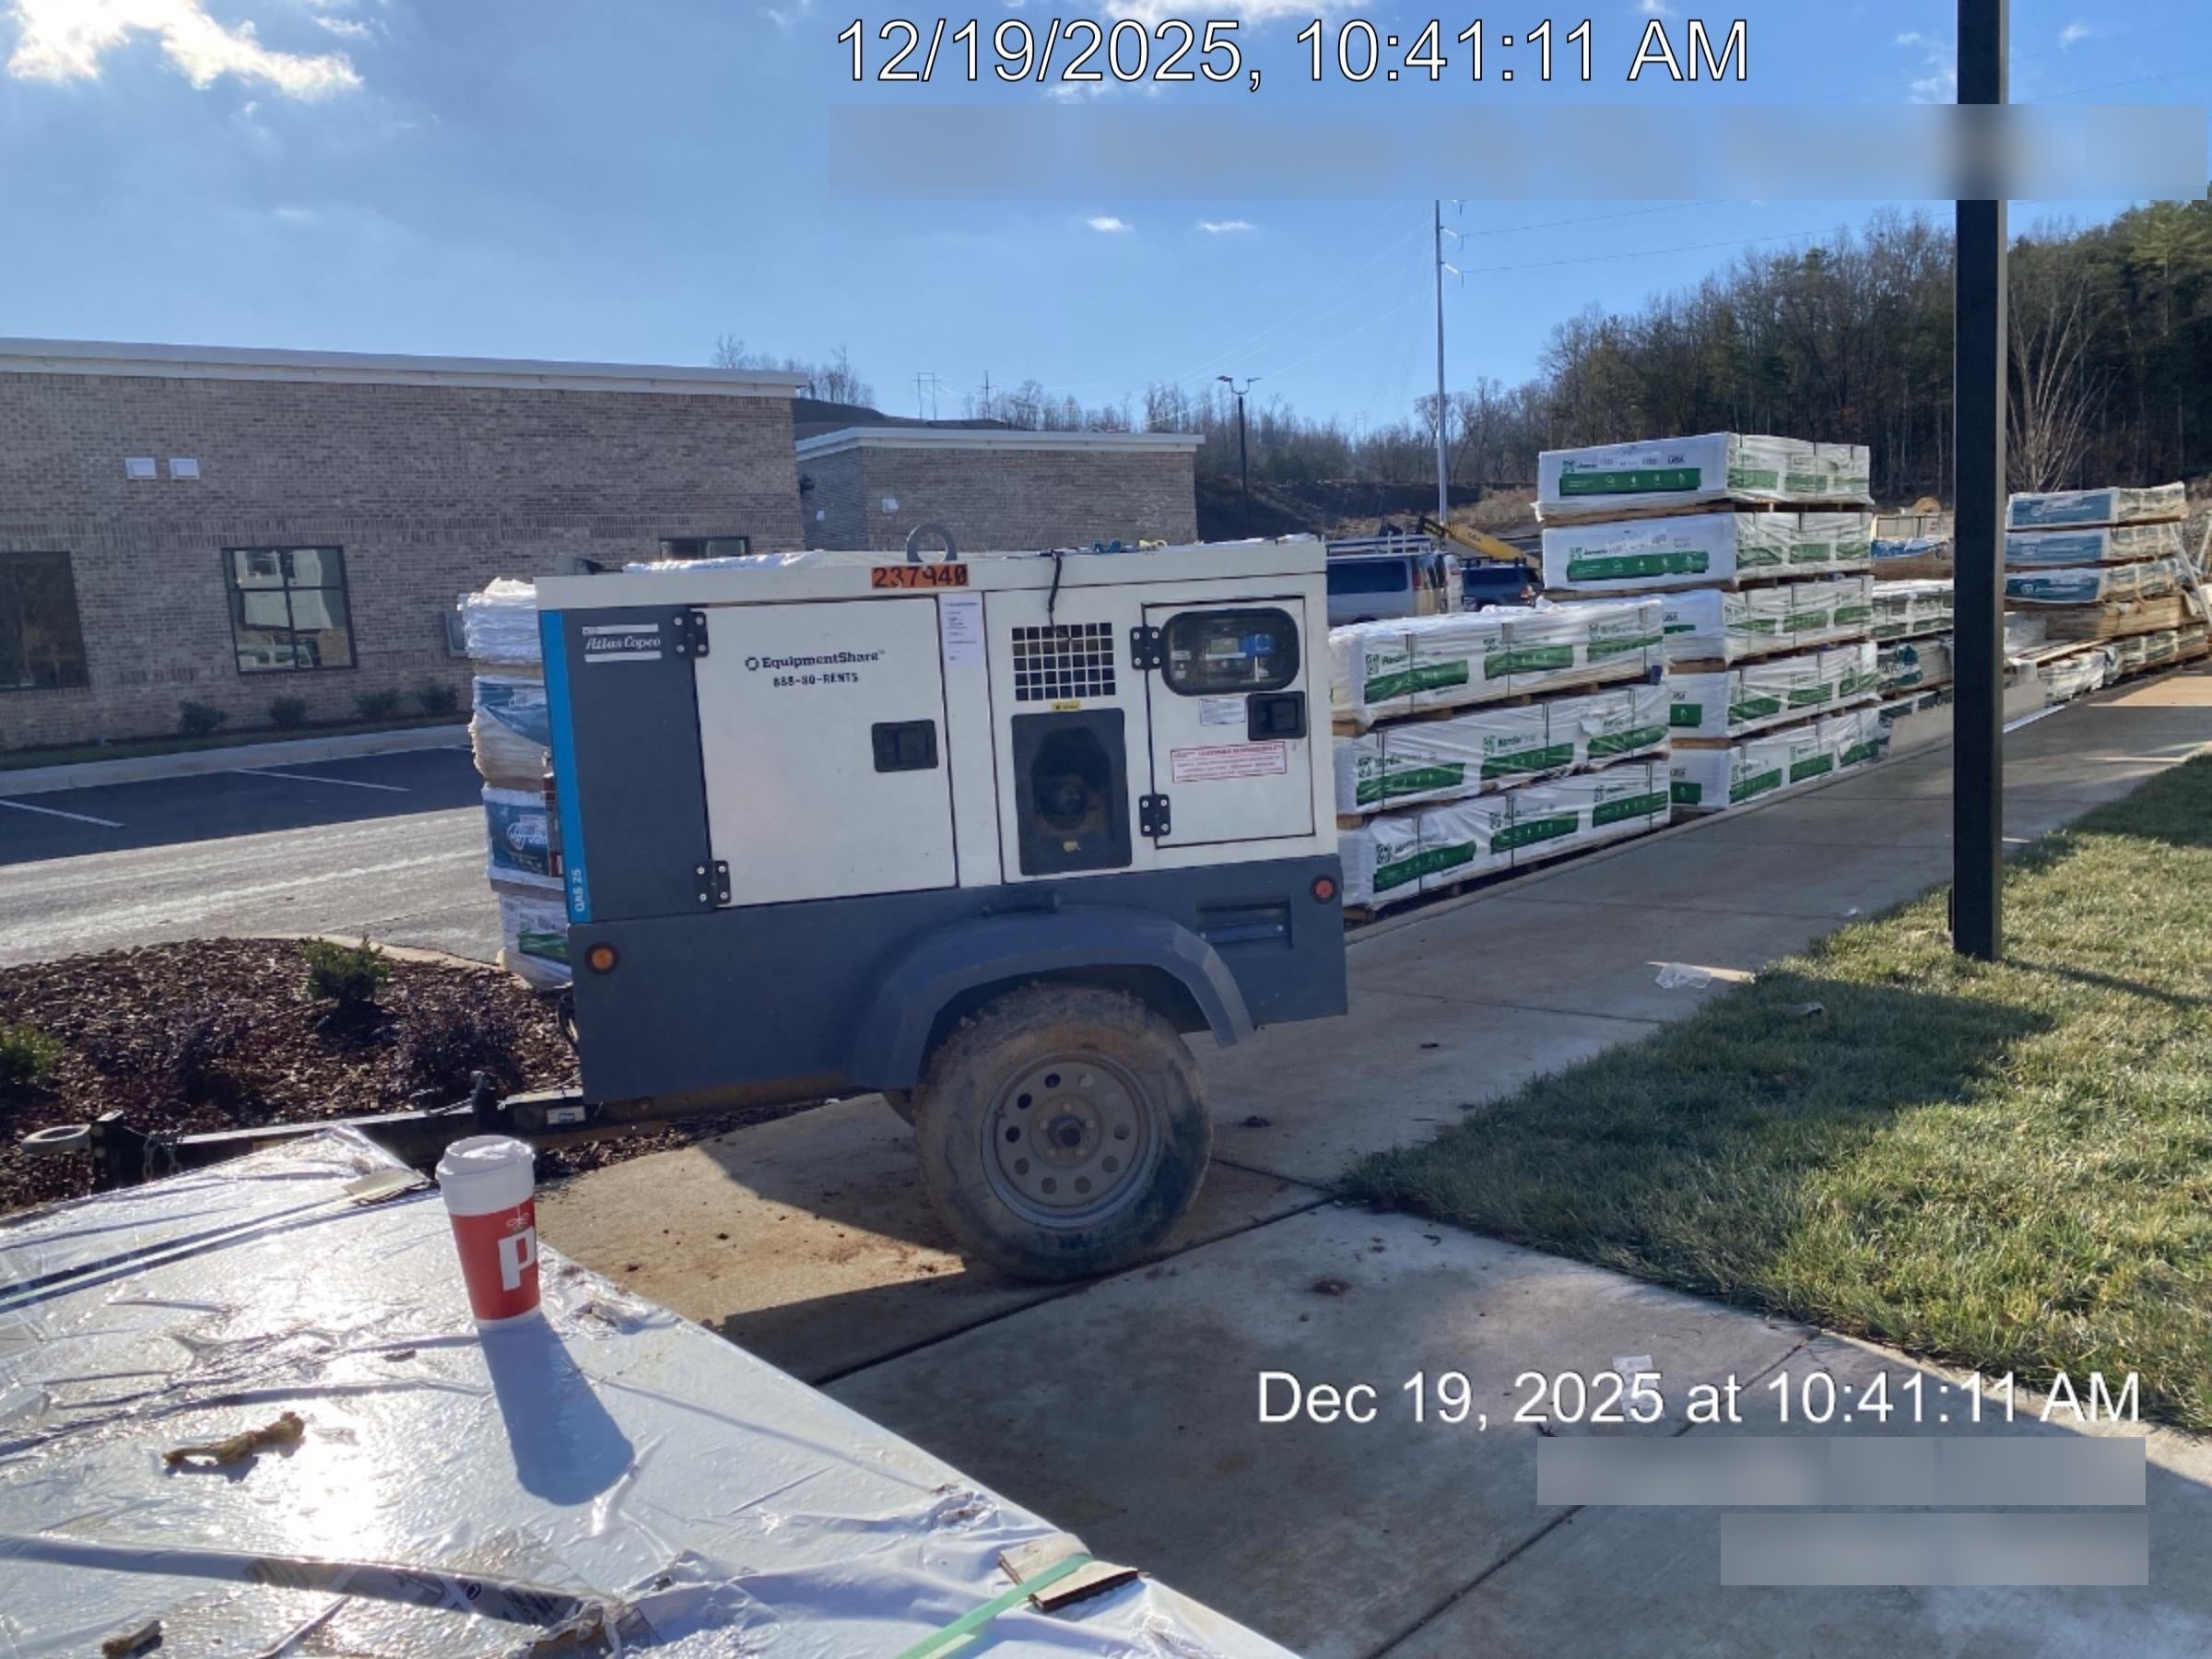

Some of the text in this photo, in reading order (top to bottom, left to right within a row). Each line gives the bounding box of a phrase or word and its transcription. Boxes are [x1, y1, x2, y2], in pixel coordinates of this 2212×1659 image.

[872, 564, 968, 588] 237940
[585, 634, 661, 650] Atlas Copco
